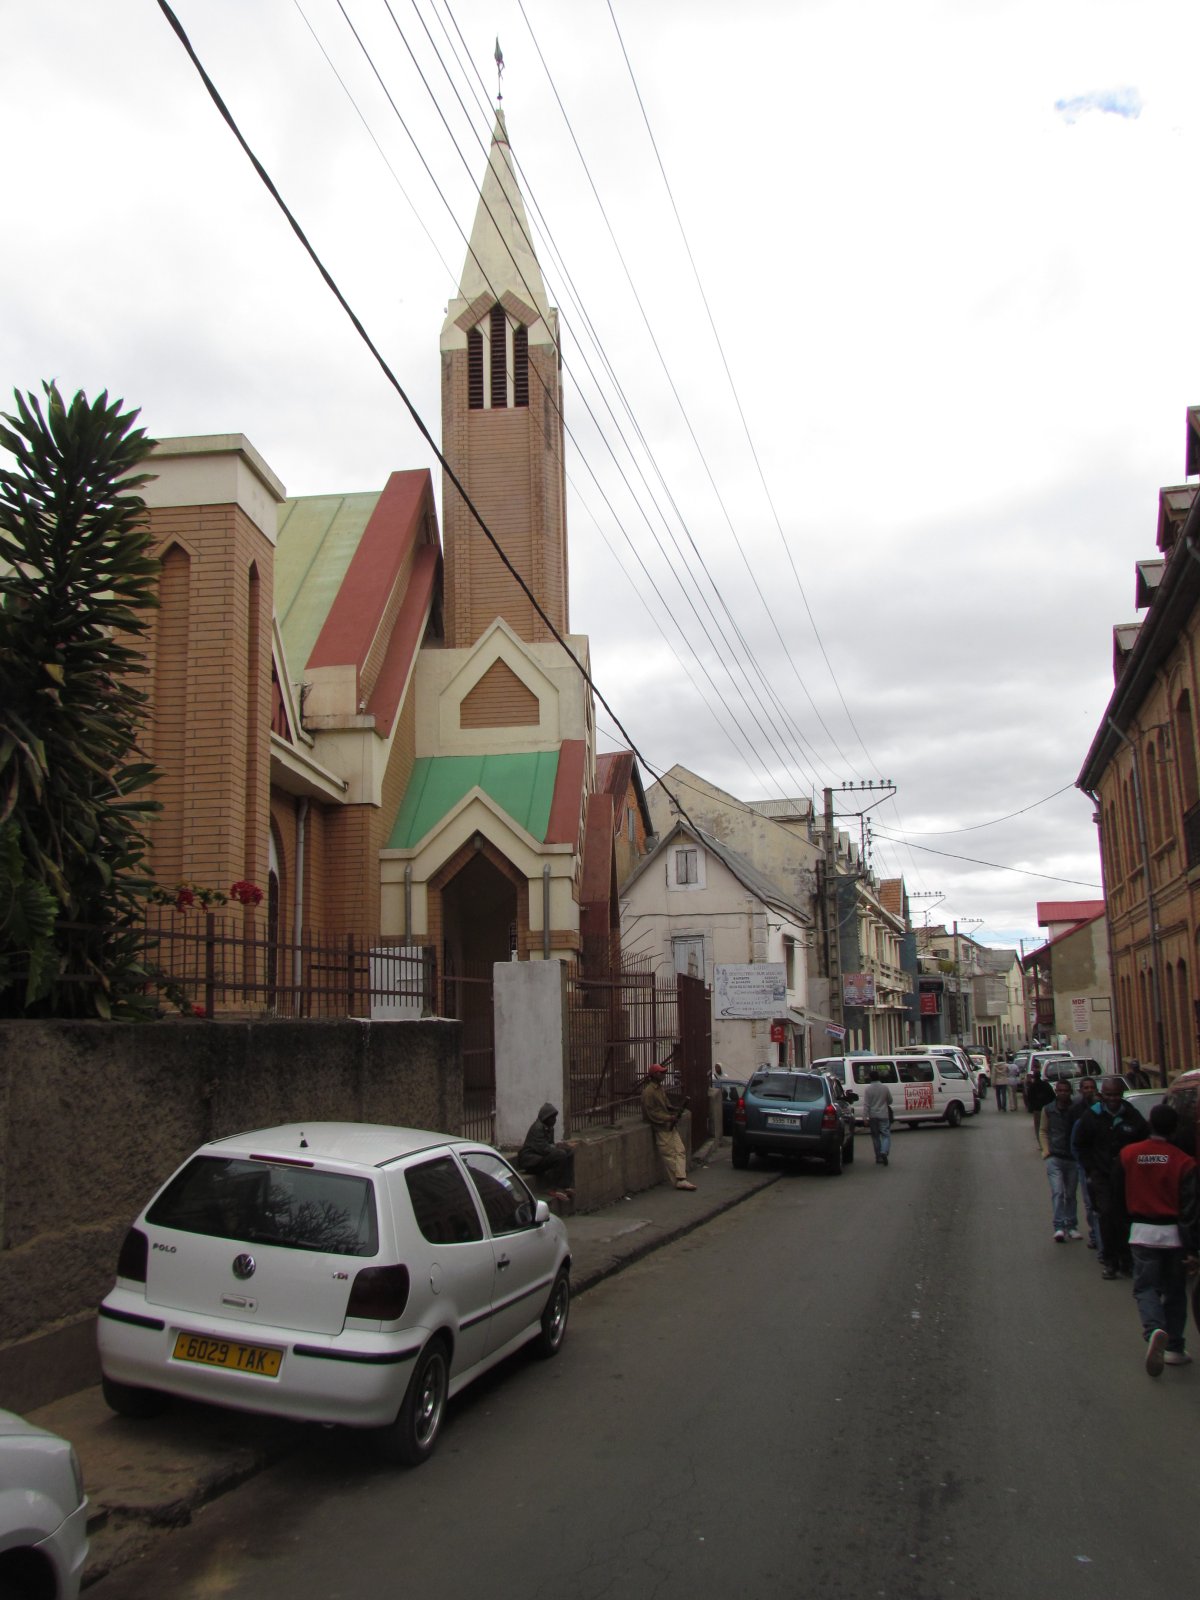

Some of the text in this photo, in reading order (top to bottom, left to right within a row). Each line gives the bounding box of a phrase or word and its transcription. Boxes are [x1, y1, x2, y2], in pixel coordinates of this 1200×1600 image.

[907, 1098, 931, 1110] PIZZA
[1137, 1154, 1169, 1164] HAWKS
[152, 1243, 177, 1254] POLO
[186, 1338, 270, 1372] 6029 TAK
